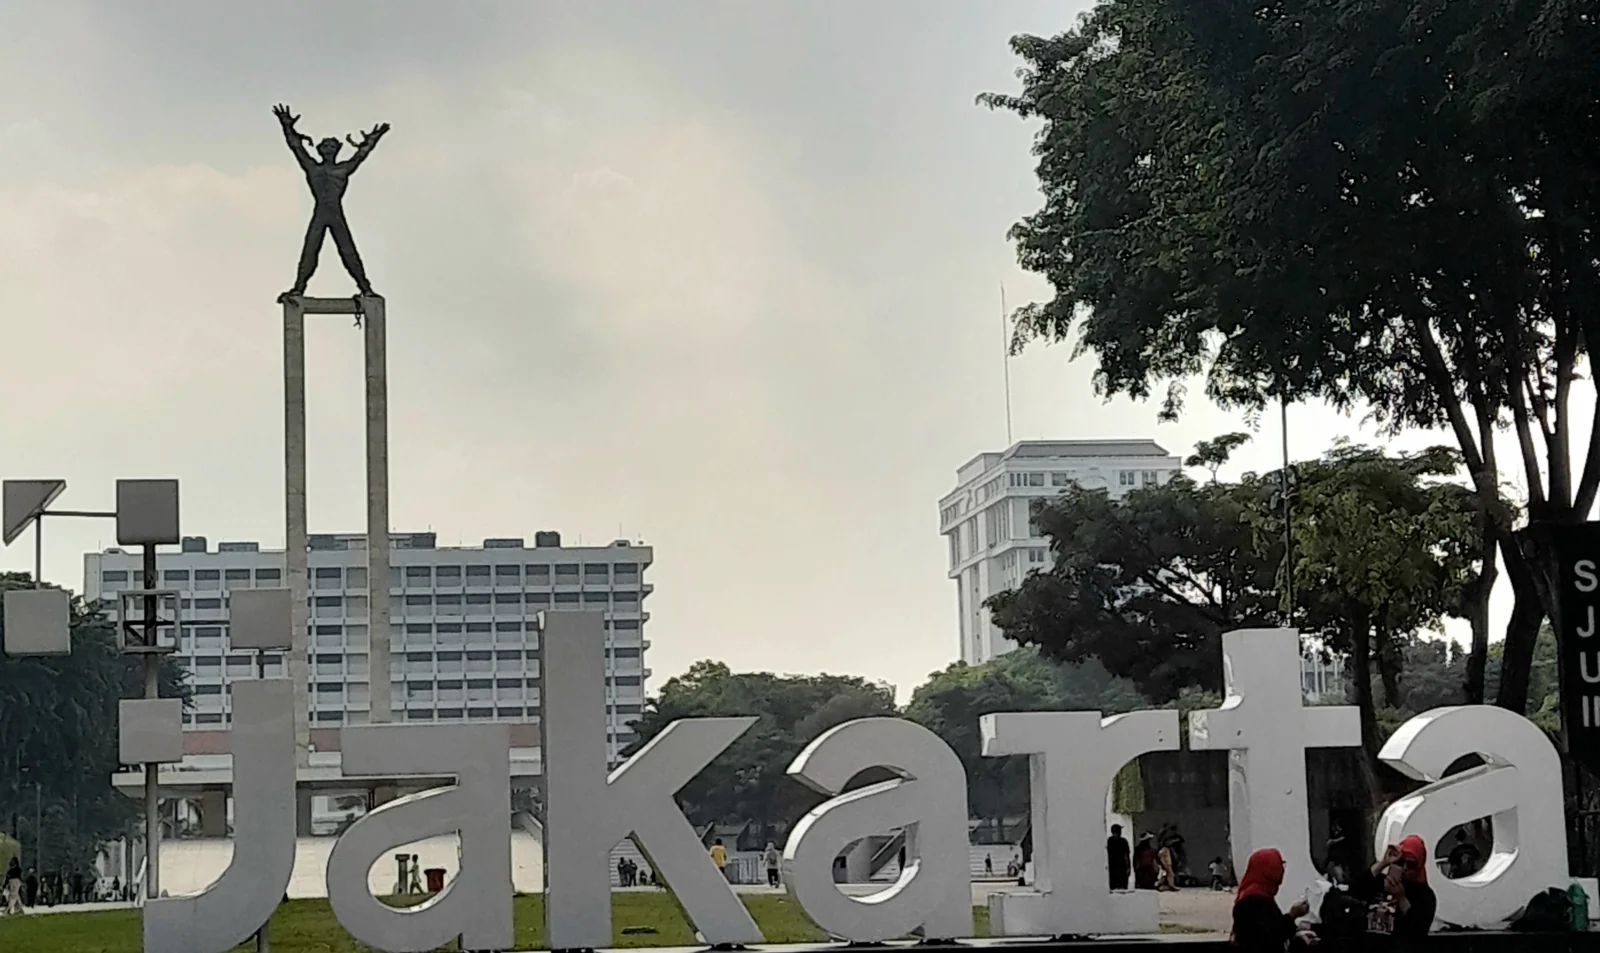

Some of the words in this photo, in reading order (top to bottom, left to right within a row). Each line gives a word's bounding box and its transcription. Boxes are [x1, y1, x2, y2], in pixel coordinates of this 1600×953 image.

[1574, 559, 1599, 592] S
[1576, 605, 1595, 638] J
[143, 589, 1568, 953] jakarta
